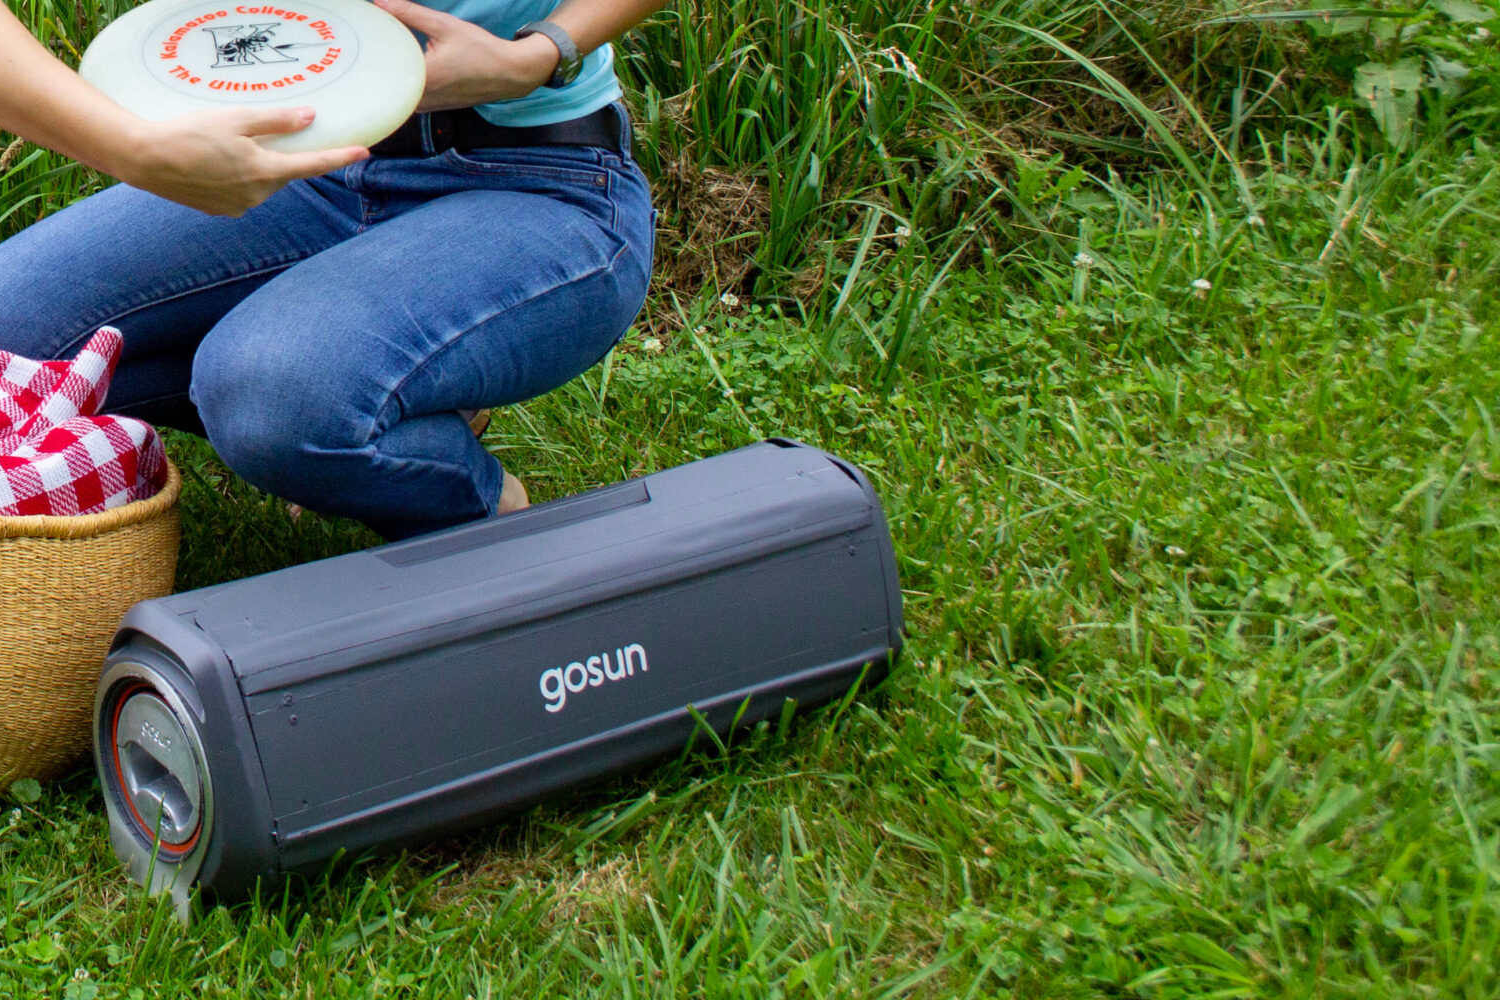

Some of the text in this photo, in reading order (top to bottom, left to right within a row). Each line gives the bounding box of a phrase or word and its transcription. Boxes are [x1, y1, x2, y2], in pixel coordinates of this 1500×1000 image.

[160, 5, 337, 60] Kalamazoo College Disc
[168, 47, 342, 92] The Ultimate Buzz
[539, 642, 649, 713] gosun
